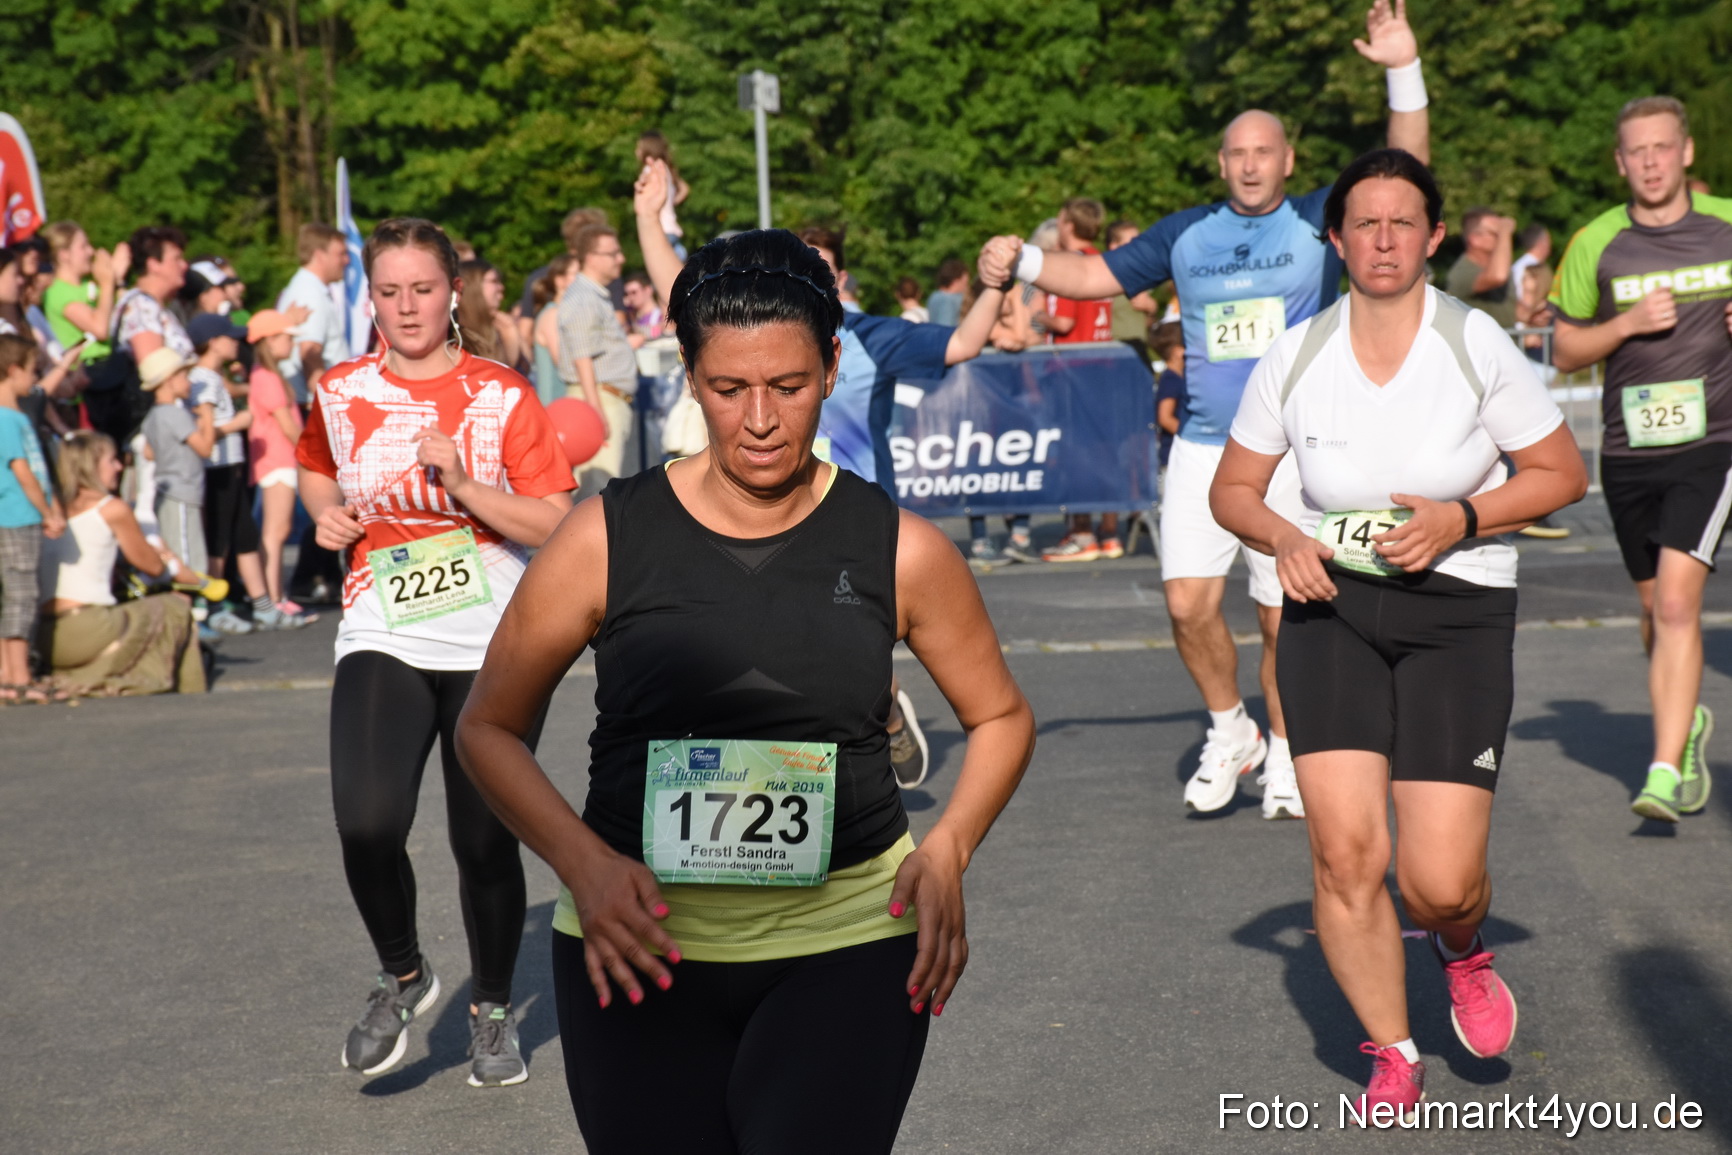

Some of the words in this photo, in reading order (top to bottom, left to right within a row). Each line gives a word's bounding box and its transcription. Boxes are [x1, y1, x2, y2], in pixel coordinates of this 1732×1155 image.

[1224, 278, 1253, 290] TEAM
[1641, 405, 1686, 428] 325
[389, 558, 470, 604] 2225
[405, 595, 444, 611] Reinhardt
[446, 590, 466, 600] Lena
[674, 768, 750, 782] firmenlauf
[791, 781, 825, 793] 2019
[669, 791, 809, 845] 1723
[691, 844, 732, 858] Ferstl
[736, 845, 787, 860] Sandra
[680, 860, 761, 872] M-motion-design
[765, 861, 794, 872] GmbH
